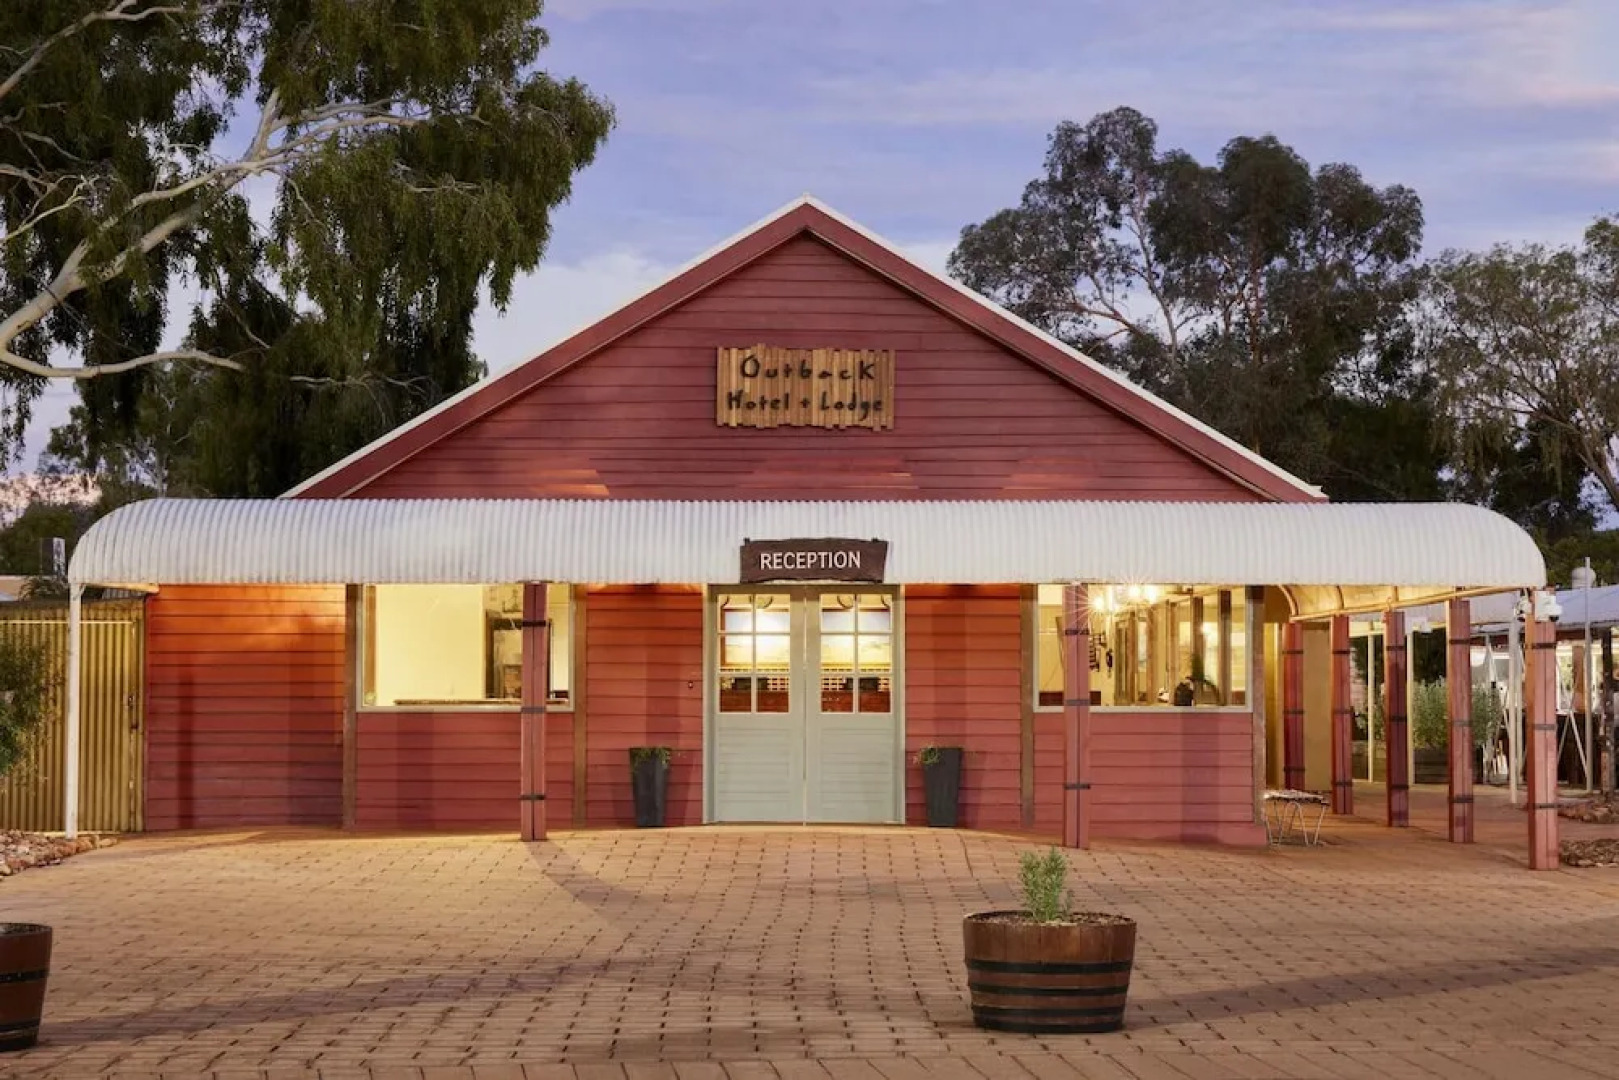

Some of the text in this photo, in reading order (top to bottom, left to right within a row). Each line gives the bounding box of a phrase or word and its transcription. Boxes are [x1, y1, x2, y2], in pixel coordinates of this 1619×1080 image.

[727, 389, 790, 411] Hotel
[820, 390, 883, 421] Lodge
[760, 551, 861, 570] RECEPTION
